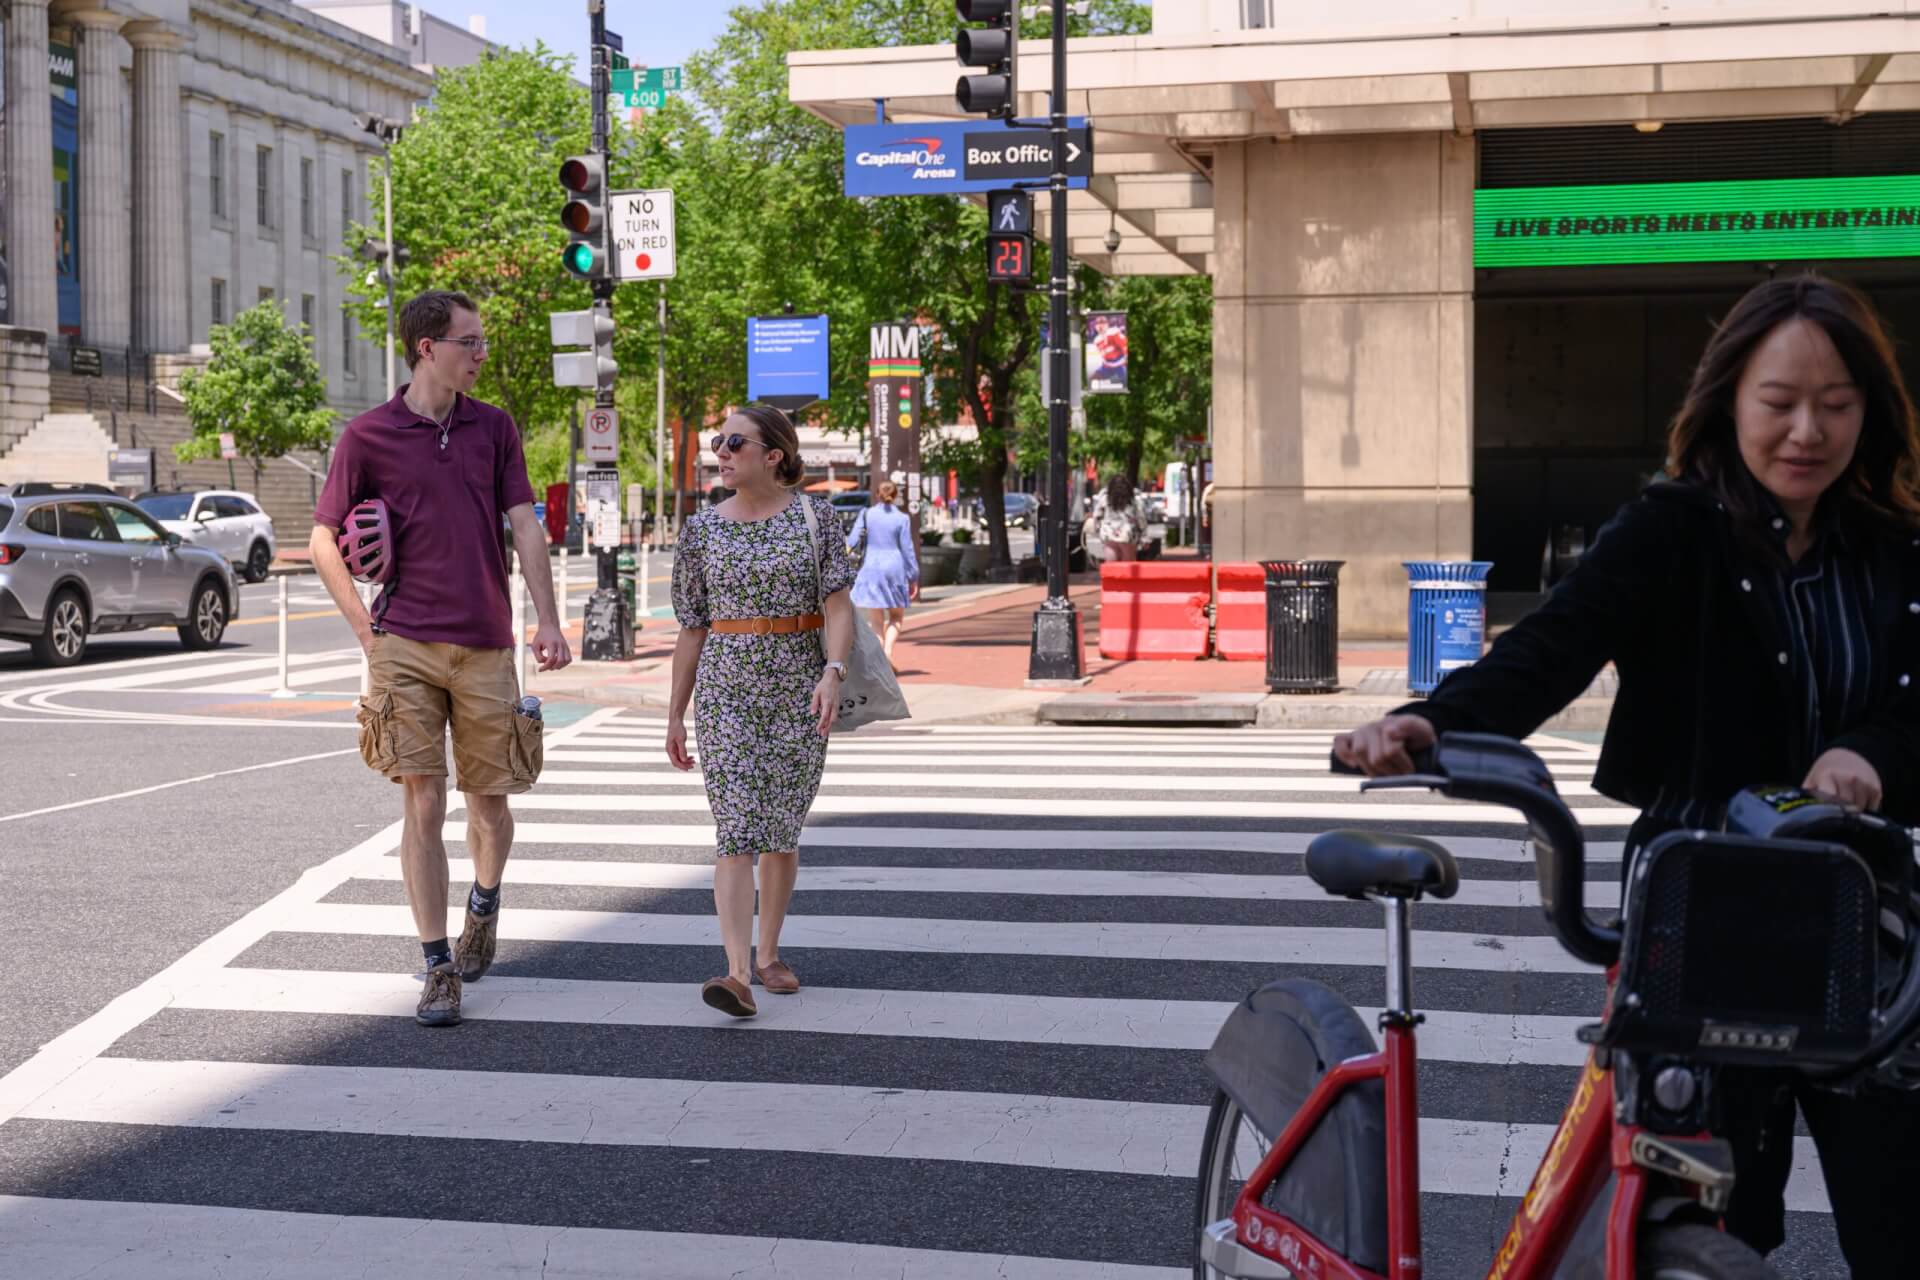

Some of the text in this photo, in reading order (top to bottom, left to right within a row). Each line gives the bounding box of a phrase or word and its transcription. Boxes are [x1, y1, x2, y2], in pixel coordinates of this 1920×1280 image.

[633, 70, 648, 90] F
[630, 91, 659, 105] 600
[968, 148, 1001, 165] Box
[912, 168, 957, 179] Arena
[629, 198, 654, 215] NO
[625, 218, 660, 233] TURN
[1494, 217, 1552, 238] LIVE
[1762, 206, 1920, 230] ENTERTAIN
[617, 235, 668, 251] ON RED
[995, 241, 1023, 275] 23
